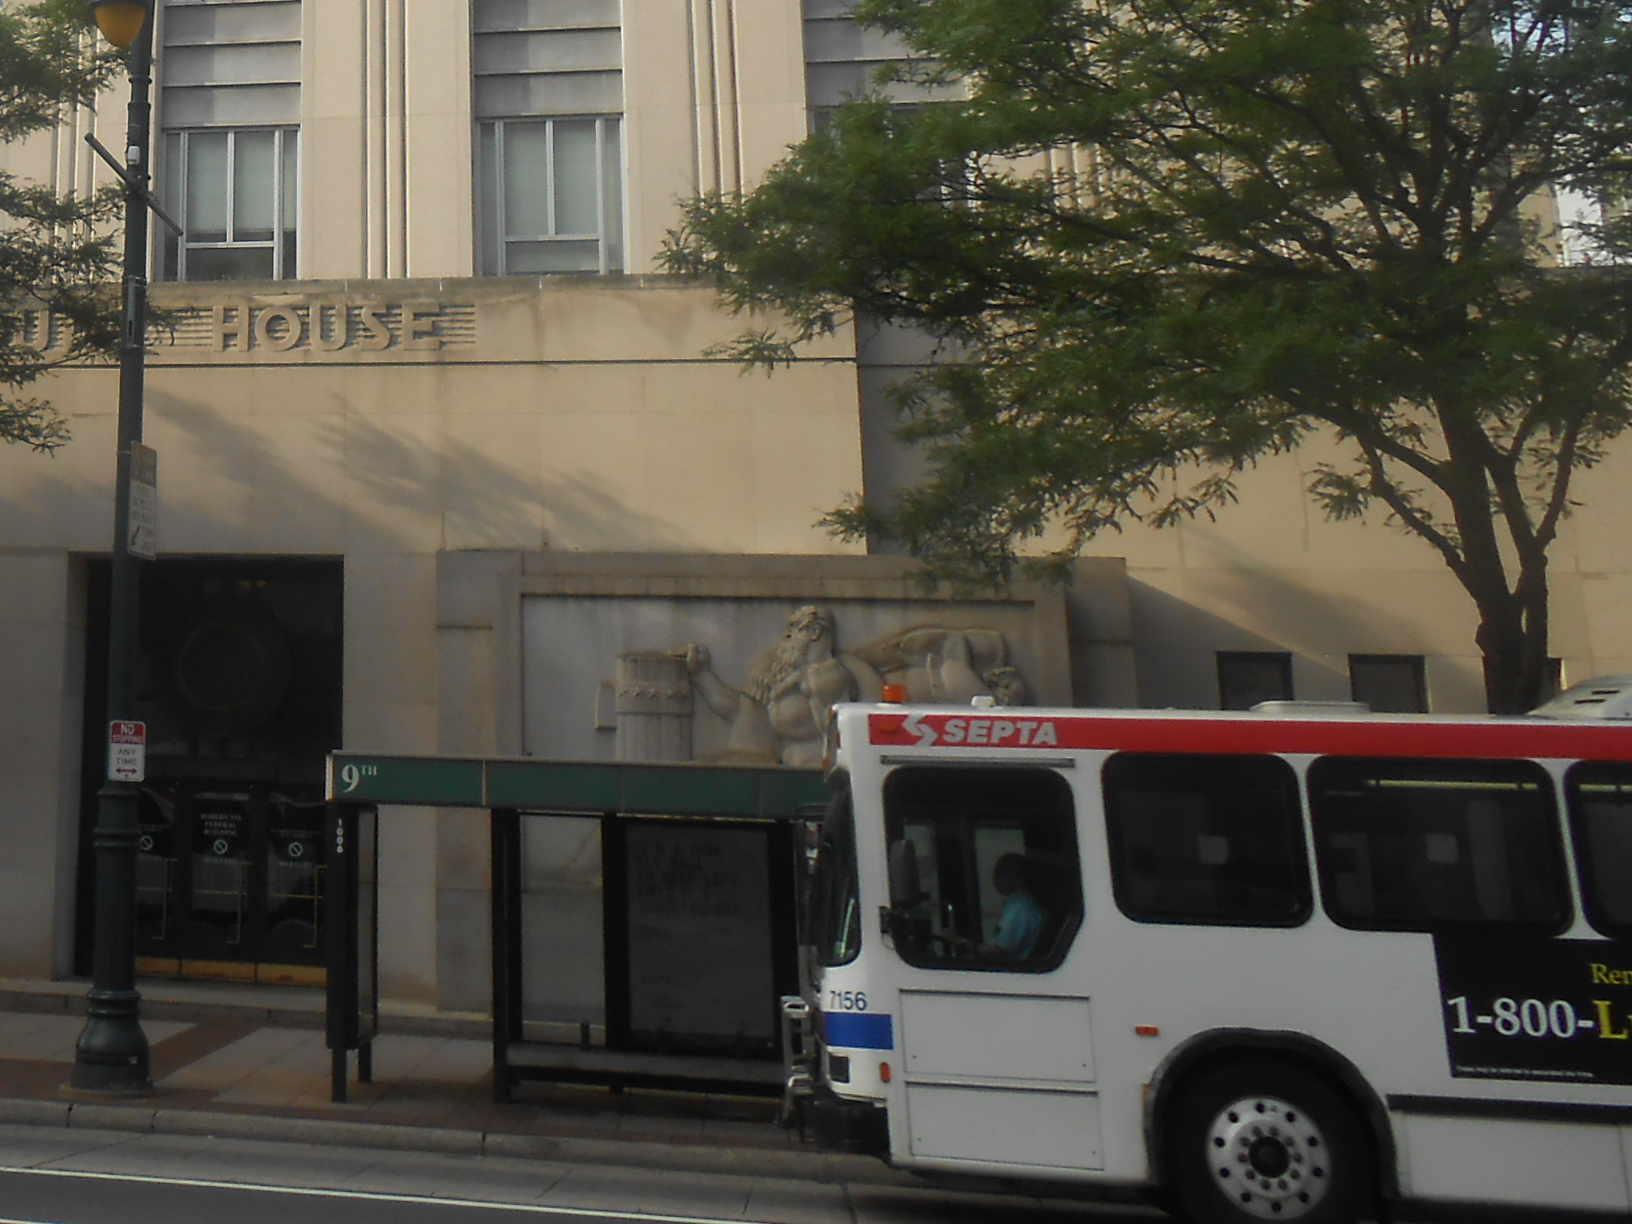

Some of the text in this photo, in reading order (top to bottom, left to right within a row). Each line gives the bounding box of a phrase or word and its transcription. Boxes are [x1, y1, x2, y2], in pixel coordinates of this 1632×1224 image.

[209, 302, 442, 354] HOUSE
[120, 723, 135, 735] NO
[942, 718, 1058, 745] SEPTA
[116, 757, 137, 766] TIME
[117, 748, 137, 756] ANY
[341, 763, 378, 793] 9TH
[830, 990, 867, 1011] 7156
[1447, 995, 1632, 1040] 1-800-L
